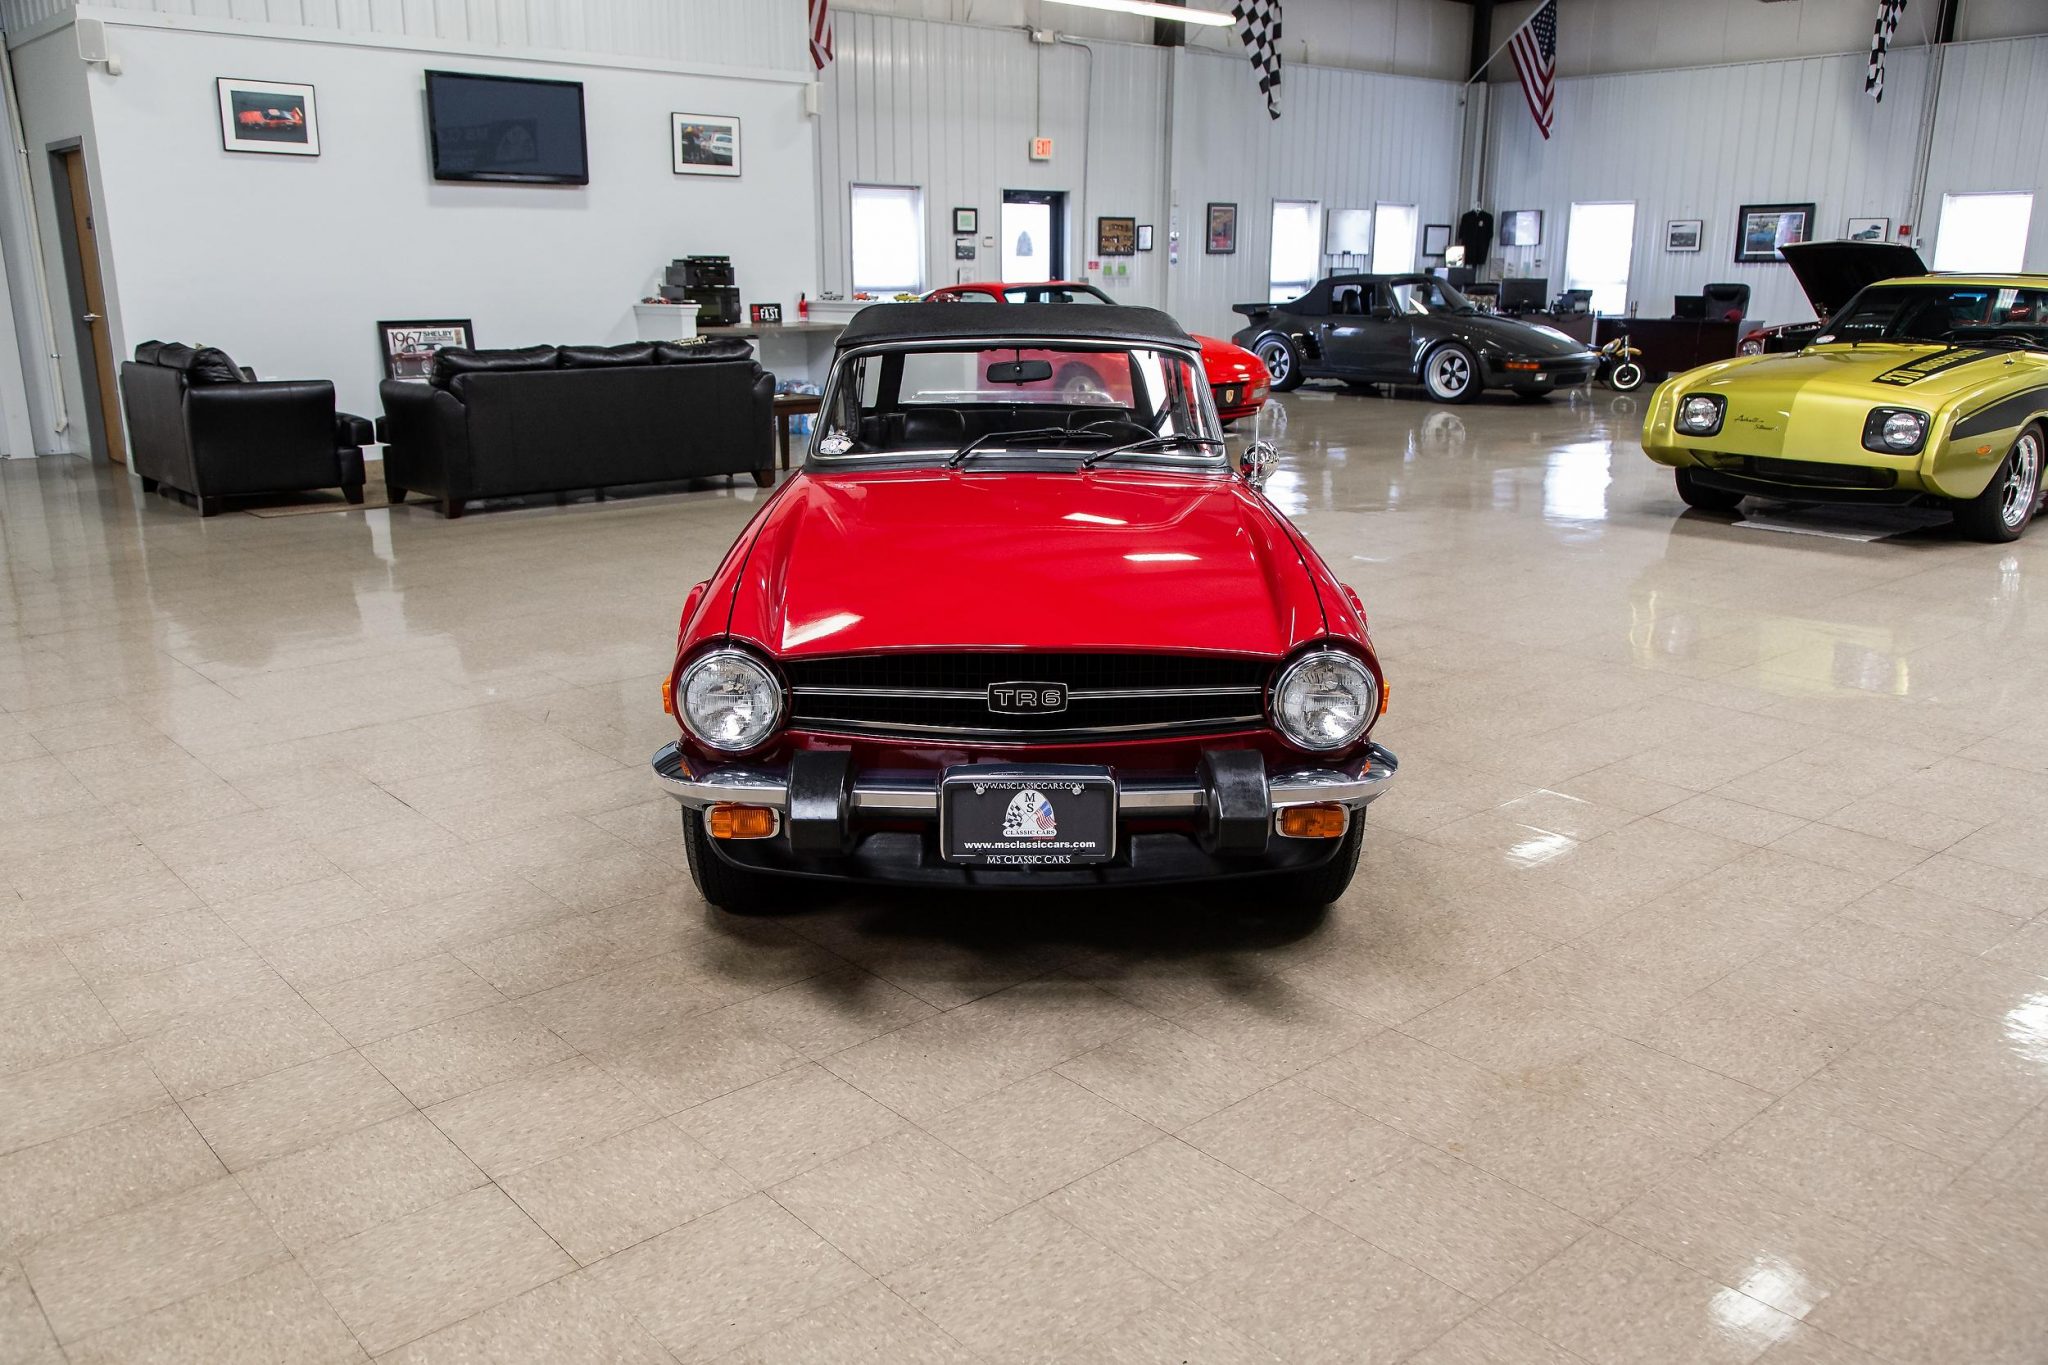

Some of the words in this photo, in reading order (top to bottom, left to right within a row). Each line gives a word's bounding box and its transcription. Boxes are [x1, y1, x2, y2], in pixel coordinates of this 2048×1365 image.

[1036, 139, 1052, 156] EXIT
[760, 308, 779, 319] FAST
[390, 331, 422, 347] 1967
[994, 689, 1061, 707] TR6
[972, 782, 1086, 790] WWW.MSCLASSICCARS.COM
[1025, 793, 1036, 803] M
[1027, 803, 1034, 813] S
[964, 840, 1096, 849] www.msclassiccars.com
[986, 856, 1001, 864] MS
[1005, 855, 1043, 865] CLASSIC
[1044, 855, 1072, 864] CARS
